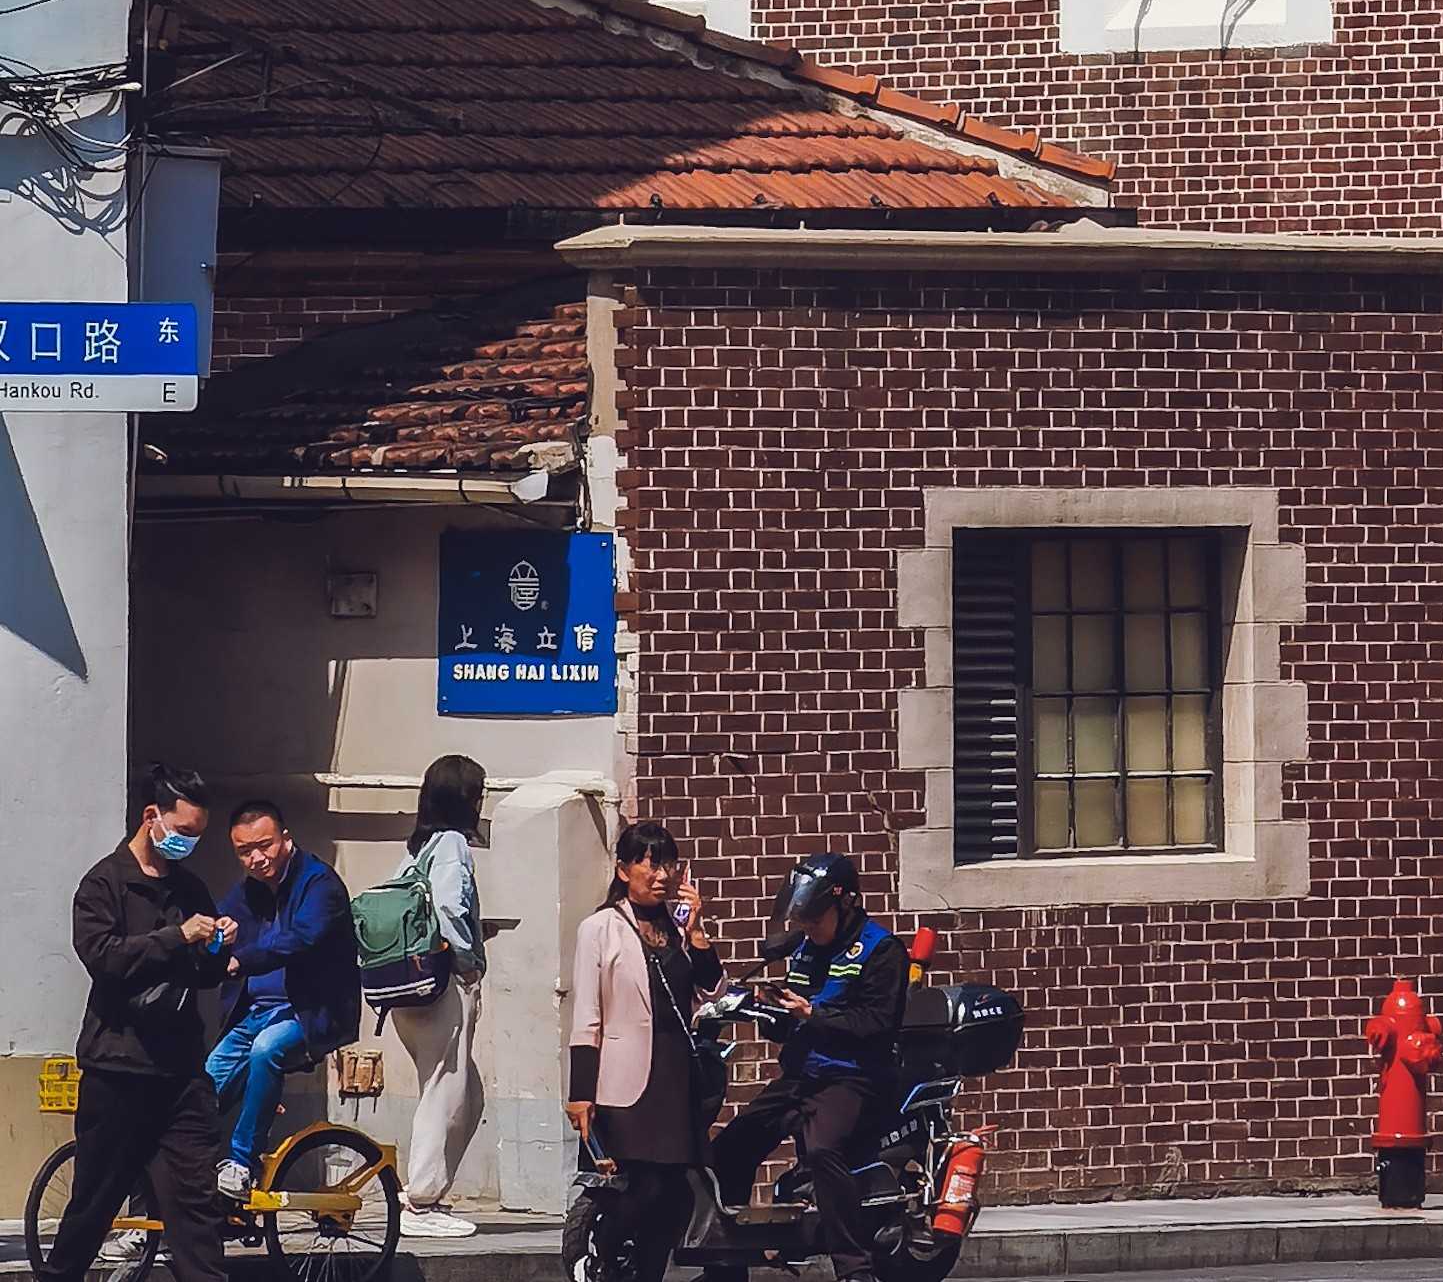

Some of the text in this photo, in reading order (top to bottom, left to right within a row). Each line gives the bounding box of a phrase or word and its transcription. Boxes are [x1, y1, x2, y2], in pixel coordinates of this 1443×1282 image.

[158, 316, 180, 344] 东
[69, 381, 100, 399] Rd.
[162, 382, 177, 403] E
[454, 623, 599, 654] 上海立信
[452, 663, 600, 682] SHANG HAI LIXIN
